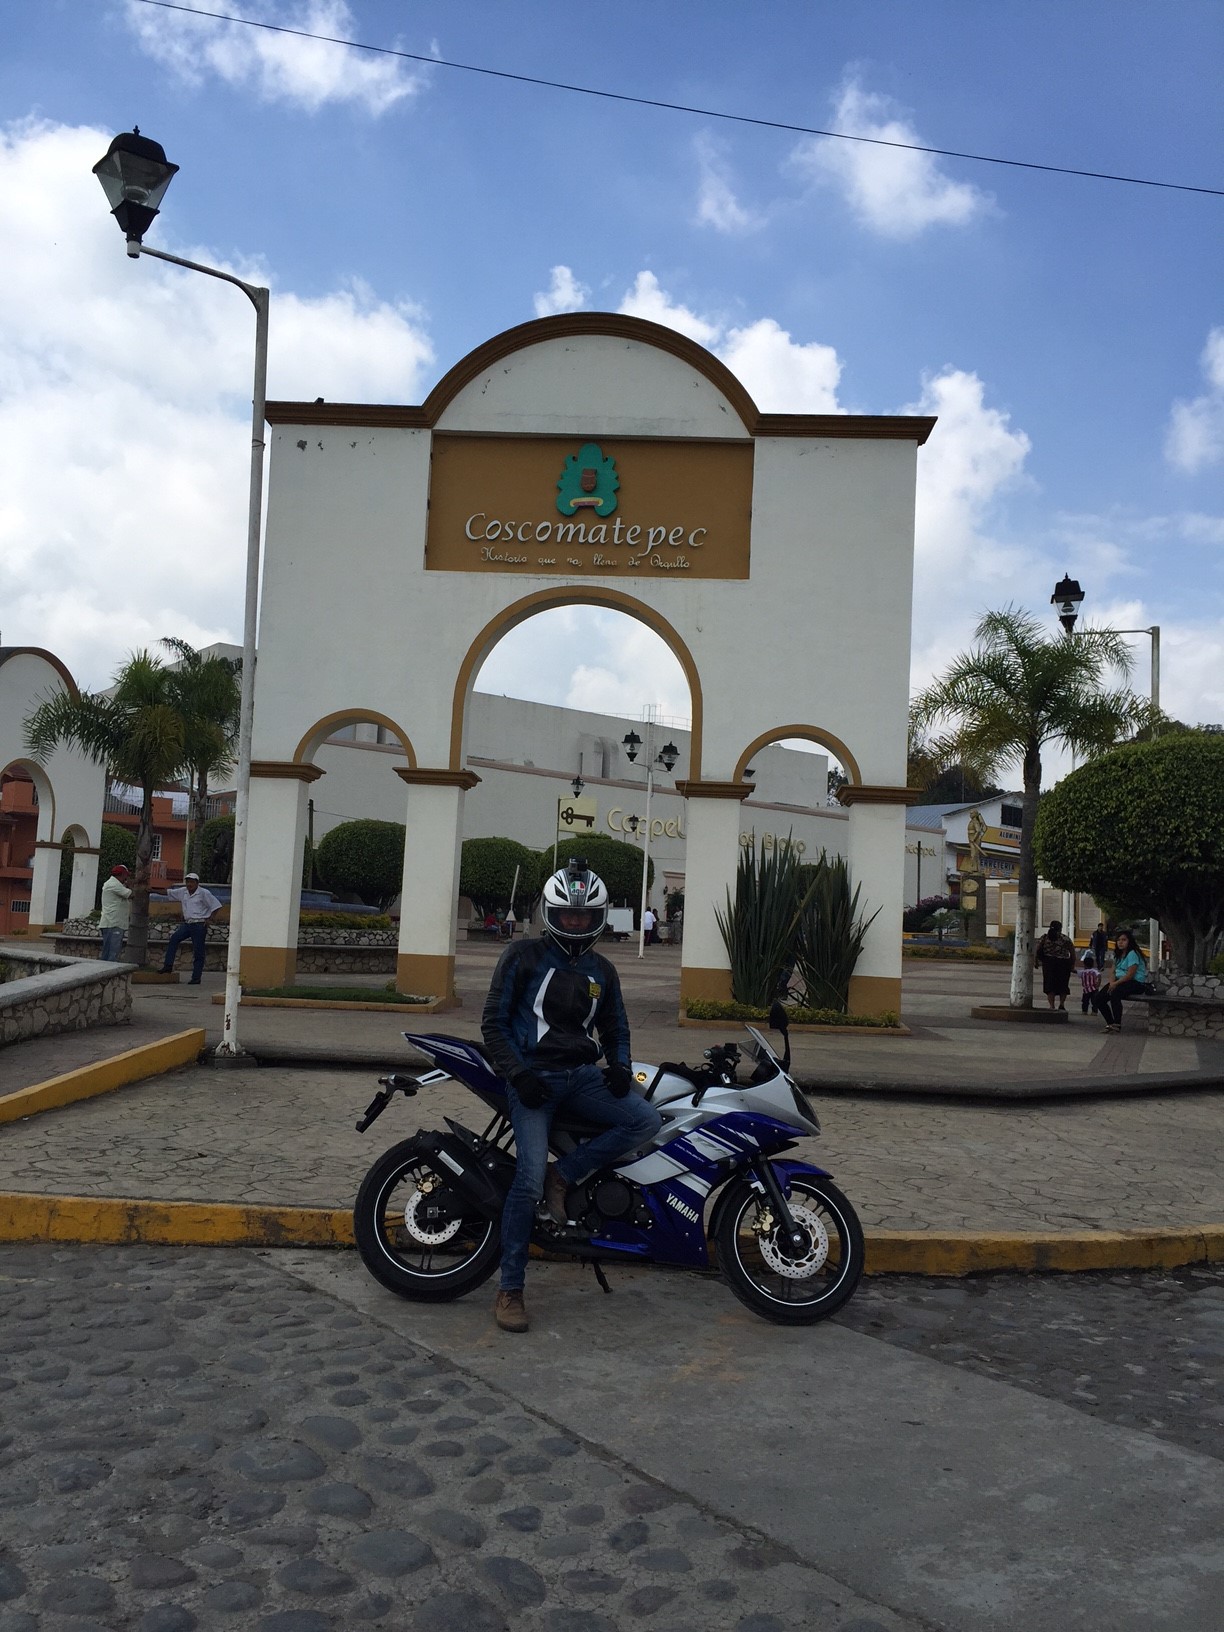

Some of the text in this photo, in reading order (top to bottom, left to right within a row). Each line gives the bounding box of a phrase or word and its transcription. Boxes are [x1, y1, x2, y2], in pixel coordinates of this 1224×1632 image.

[465, 512, 708, 557] Coscomatepec
[537, 556, 557, 566] que
[628, 557, 642, 567] de
[650, 554, 690, 570] Orgullo
[980, 858, 1017, 870] ERRETERIA
[665, 1193, 700, 1224] YAMAHA
